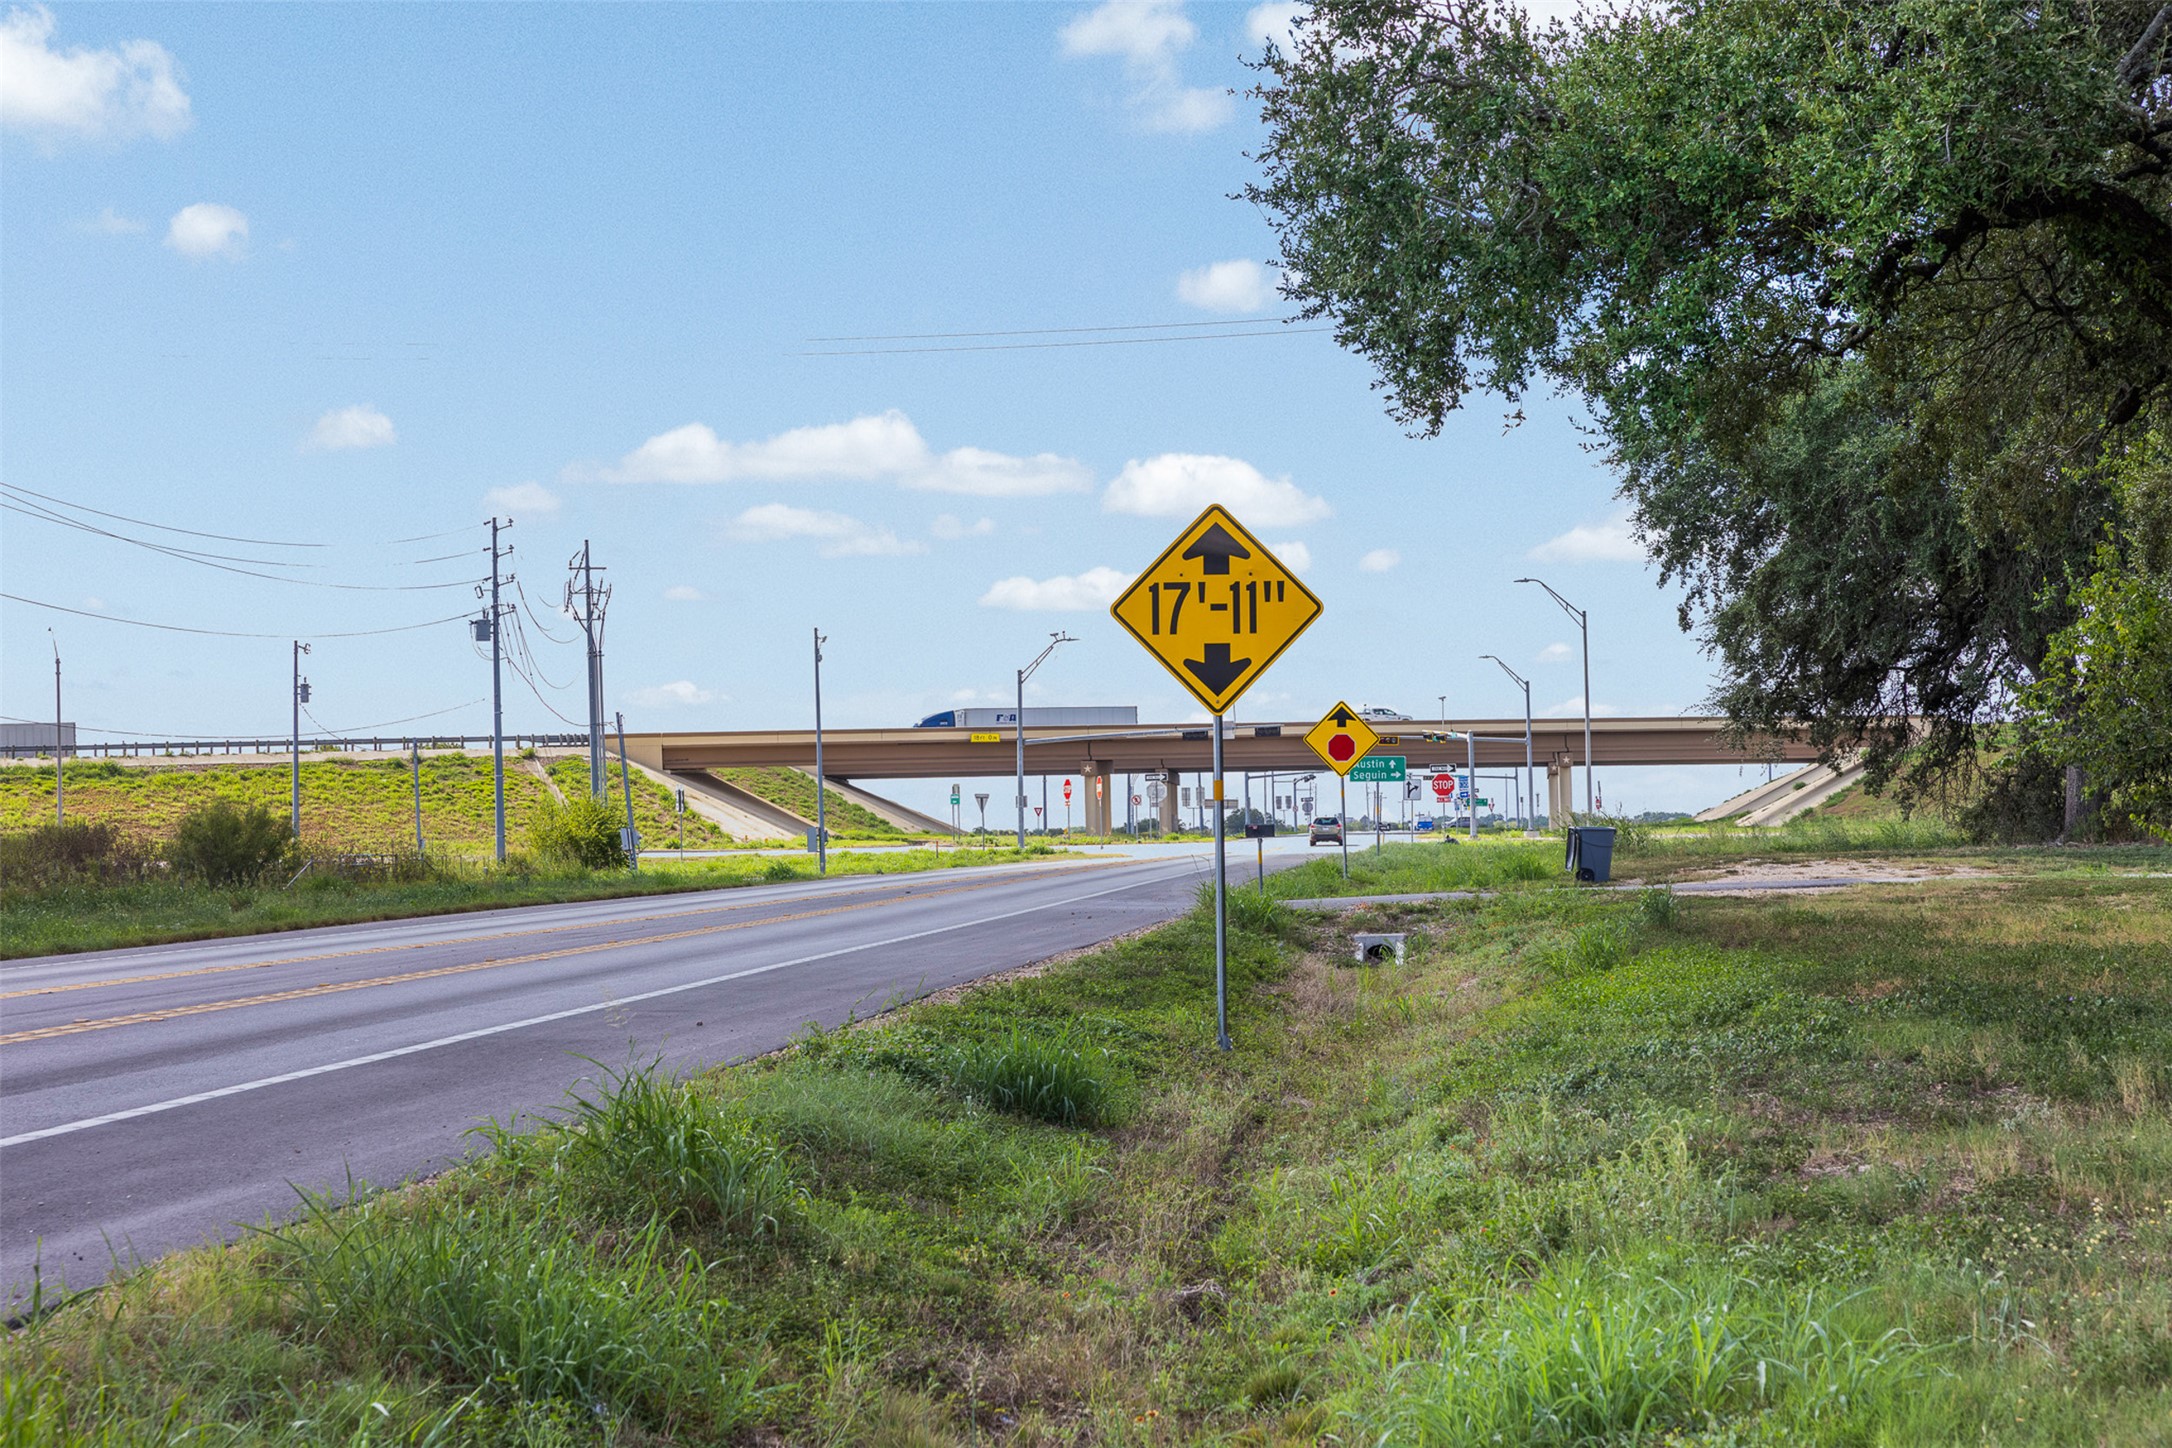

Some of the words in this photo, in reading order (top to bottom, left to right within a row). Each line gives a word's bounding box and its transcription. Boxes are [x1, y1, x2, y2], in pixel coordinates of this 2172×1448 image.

[1148, 580, 1285, 635] 17'-11"
[1353, 771, 1387, 781] Seguin
[1433, 780, 1454, 790] STOP
